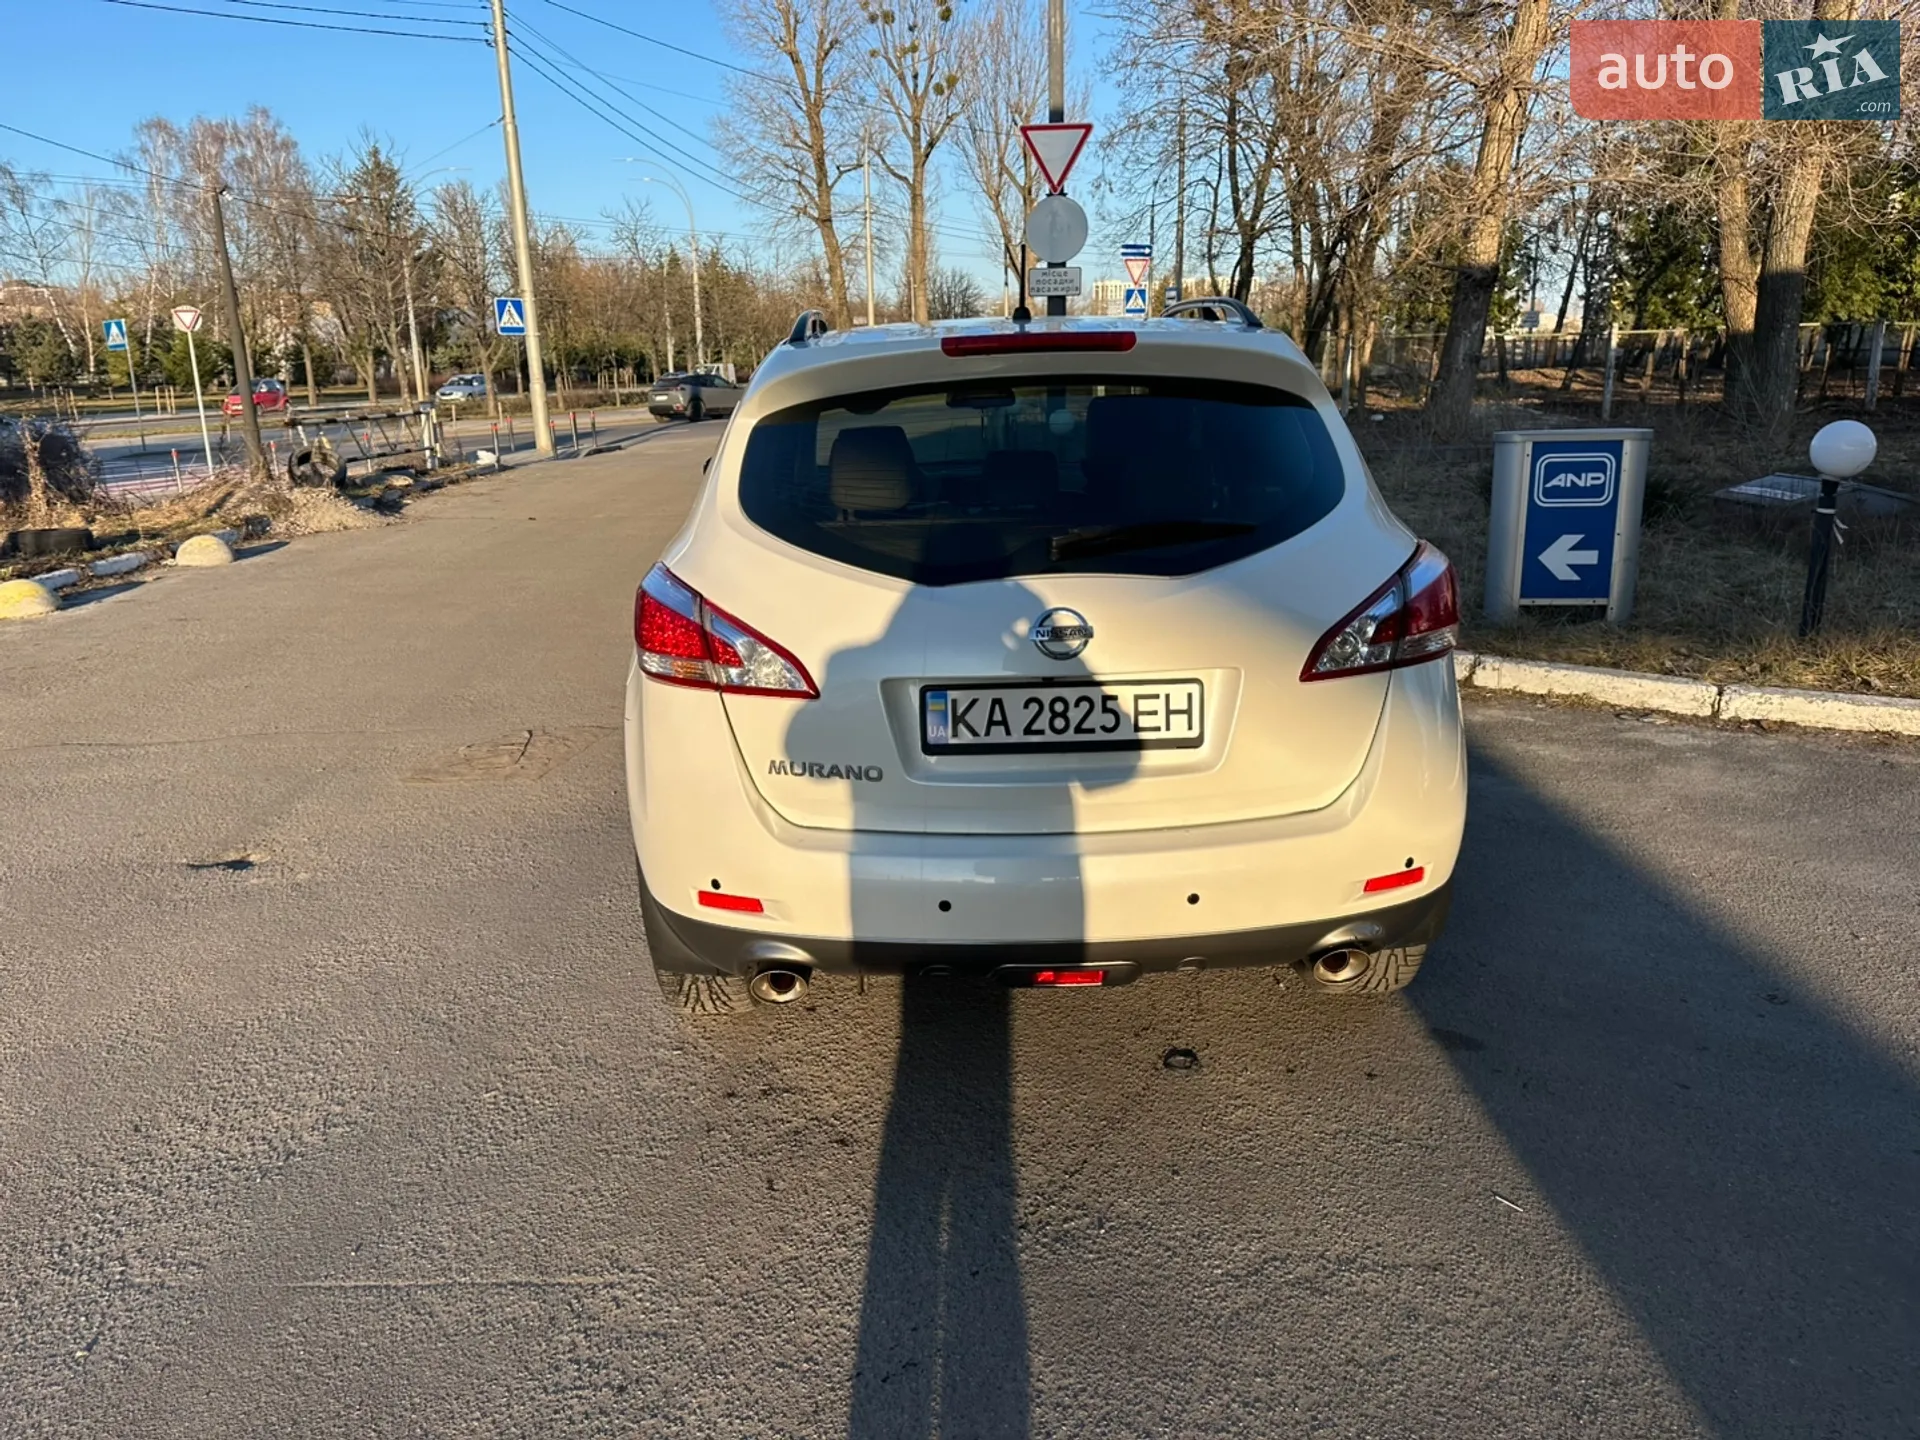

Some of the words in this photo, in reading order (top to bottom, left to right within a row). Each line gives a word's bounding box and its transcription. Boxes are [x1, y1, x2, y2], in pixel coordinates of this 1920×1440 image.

[1544, 472, 1606, 488] ANP
[1034, 627, 1088, 639] NISSAN
[950, 697, 1012, 738] KA
[1022, 695, 1121, 736] 2825
[1132, 692, 1194, 734] EH
[928, 725, 947, 739] UA
[768, 759, 884, 783] MURANO
